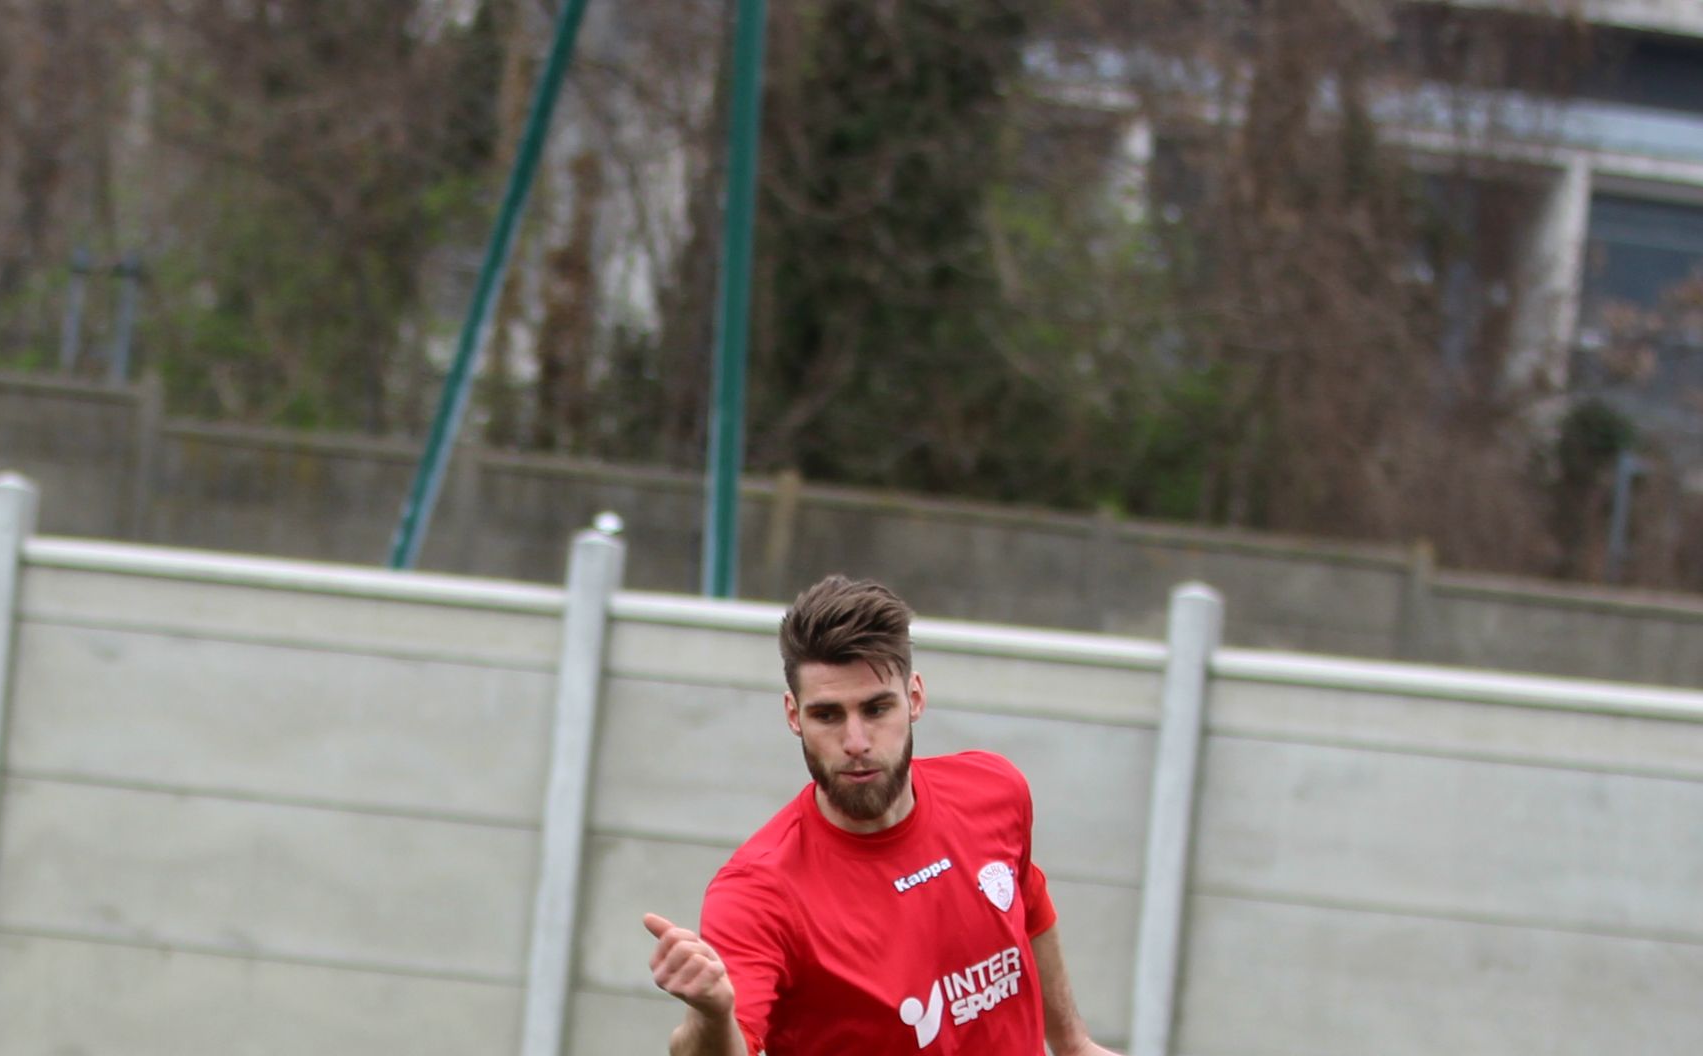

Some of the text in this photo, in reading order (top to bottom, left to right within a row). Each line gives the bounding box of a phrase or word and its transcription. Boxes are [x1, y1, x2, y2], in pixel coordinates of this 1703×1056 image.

[893, 857, 952, 892] Kappa
[942, 946, 1020, 1002] INTER
[950, 970, 1022, 1026] SPORT
